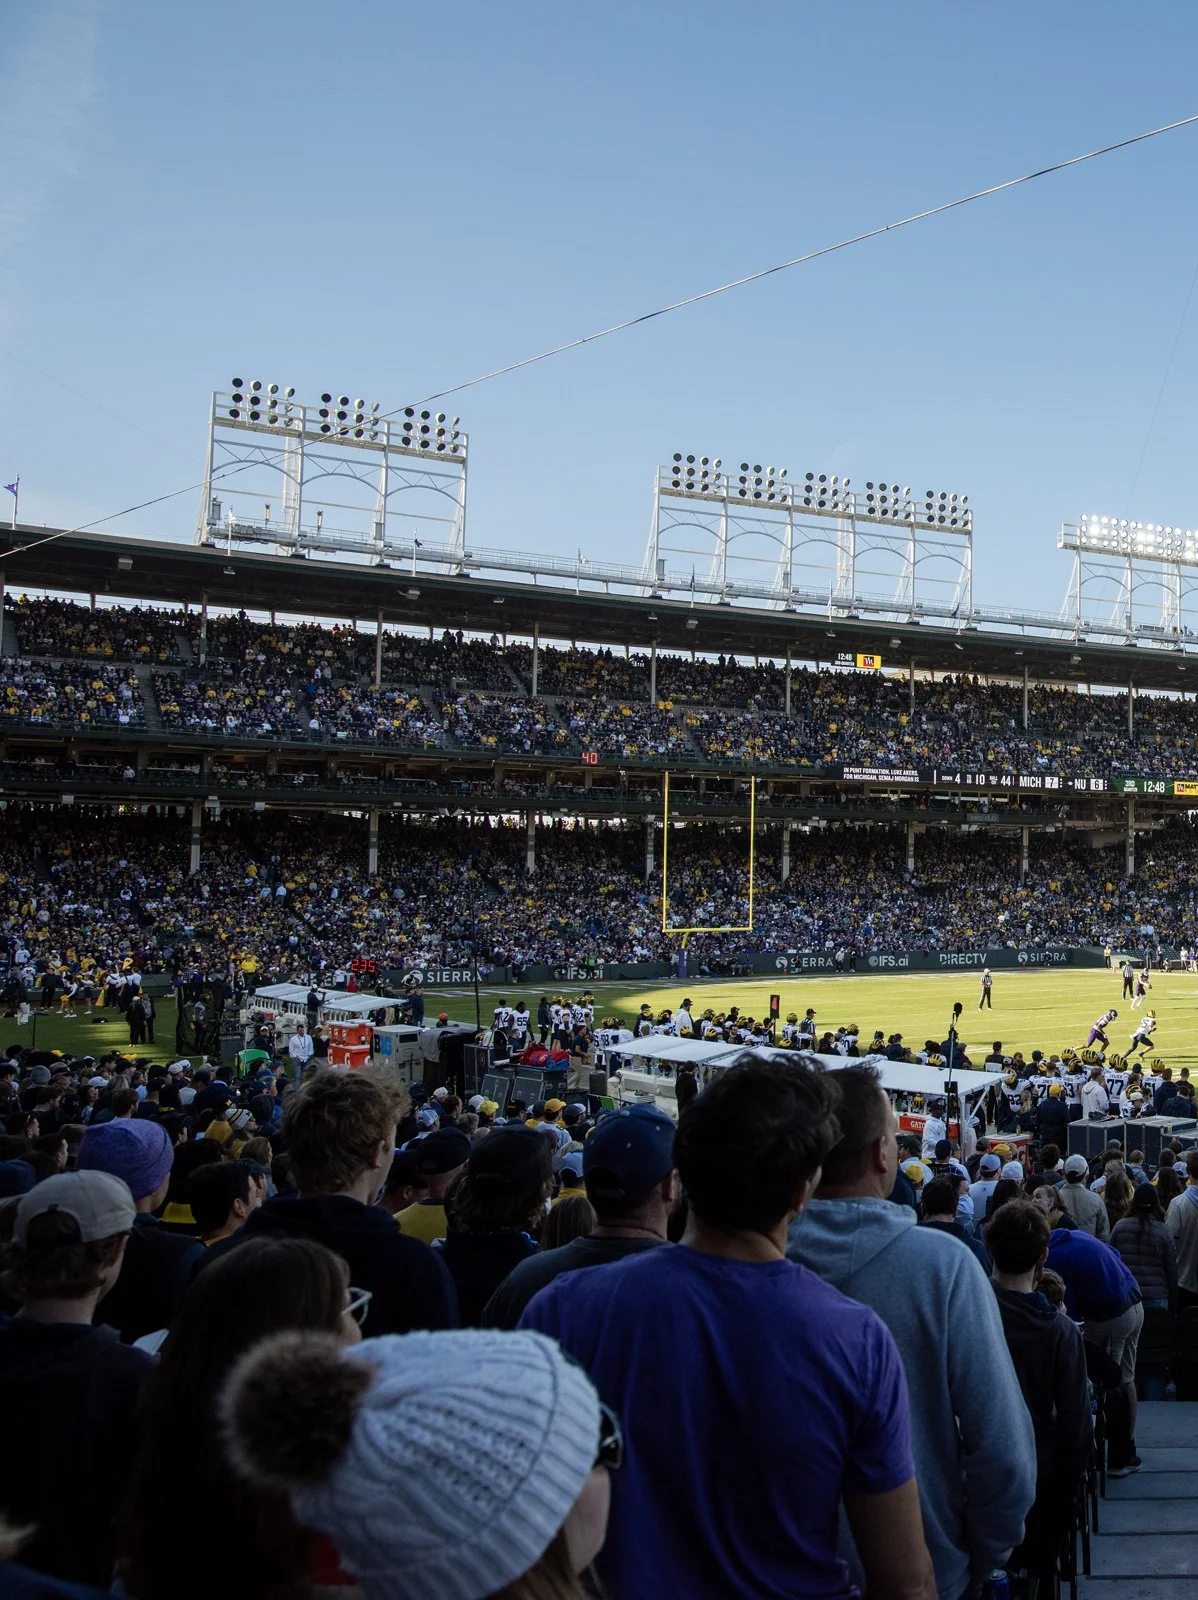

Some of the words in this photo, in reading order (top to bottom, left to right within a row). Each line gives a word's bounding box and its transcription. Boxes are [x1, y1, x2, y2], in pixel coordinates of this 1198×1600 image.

[582, 752, 597, 764] 40
[954, 773, 960, 785] 4
[976, 774, 985, 785] 10
[1000, 775, 1011, 786] 44
[1019, 776, 1042, 788] MICH
[1049, 778, 1055, 787] 7
[1074, 778, 1086, 789] NU
[1094, 779, 1100, 789] 6
[1144, 781, 1165, 793] 12:48
[790, 957, 834, 967] SERRA
[879, 953, 909, 967] IFS.ai
[939, 953, 987, 965] DIRECTV
[427, 971, 483, 983] SIERRA
[1107, 1078, 1124, 1096] 77
